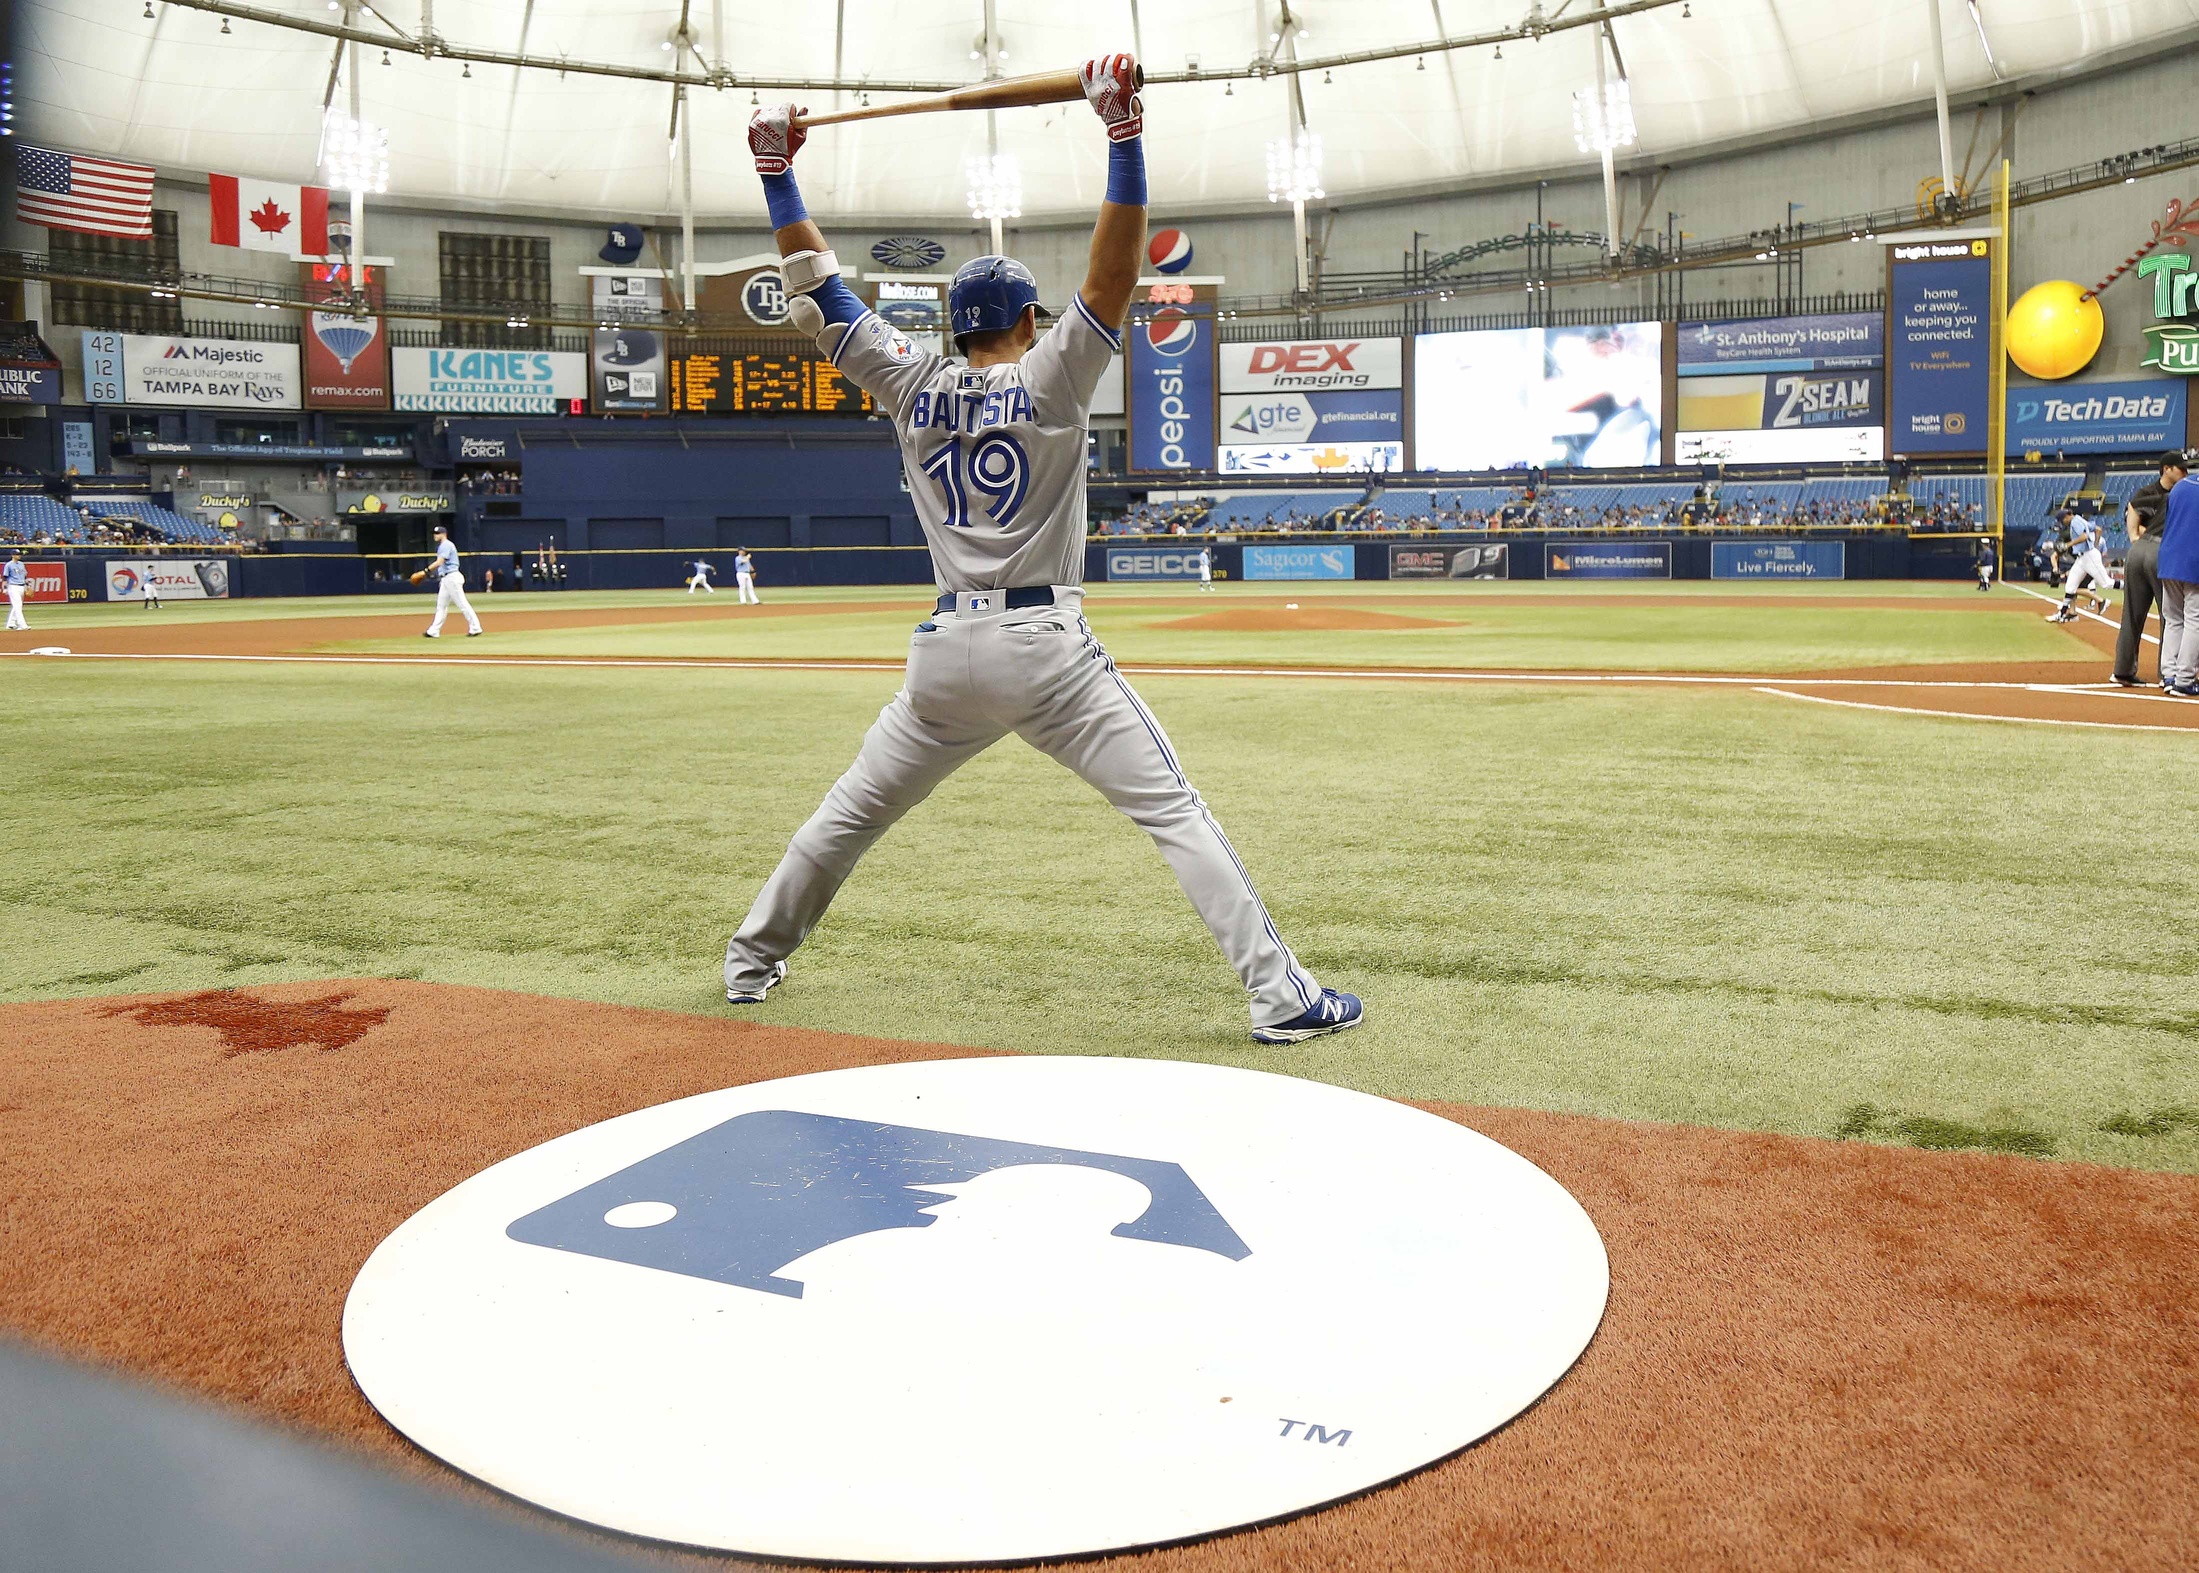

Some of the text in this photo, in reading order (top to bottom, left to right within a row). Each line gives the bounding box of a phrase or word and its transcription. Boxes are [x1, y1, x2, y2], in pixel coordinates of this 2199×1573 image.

[1895, 245, 1968, 260] bright house
[2137, 252, 2199, 319] Tr
[1924, 288, 1958, 300] home
[965, 306, 981, 319] 19
[1914, 303, 1927, 313] or
[1905, 315, 1977, 329] keeping you
[1717, 325, 1869, 346] St. Anthony's Hospital
[1908, 327, 1974, 342] connected.
[91, 336, 115, 353] 42
[193, 346, 264, 365] Majestic
[1248, 343, 1361, 374] DEX
[95, 360, 113, 376] 12
[429, 350, 553, 381] KANE'S
[143, 366, 283, 381] OFFICIAL UNIFORM OF THE
[1273, 372, 1370, 388] imaging
[93, 382, 117, 399] 66
[143, 380, 203, 395] TAMPA
[208, 383, 240, 396] BAY
[311, 386, 383, 397] remax.com
[434, 383, 547, 394] FURNITURE
[914, 386, 1032, 433] BAUTSTA
[1259, 402, 1301, 428] gte
[2044, 397, 2101, 422] Tech
[2103, 395, 2168, 419] Data
[1154, 368, 1192, 468] pepsi
[1322, 411, 1397, 424] gtefinancial.org
[1912, 415, 1940, 425] bright
[1912, 424, 1940, 432] house
[2021, 433, 2165, 447] PROUDLY SUPPORTING TAMPA BAY
[461, 446, 505, 457] PORCH
[919, 432, 1029, 527] 19
[201, 494, 250, 508] Ducky's
[400, 495, 448, 510] Ducky's
[1111, 555, 1200, 575] GEICO
[1253, 549, 1317, 570] Sagicor
[1397, 552, 1444, 566] GMC
[1737, 561, 1816, 576] Live Fiercely.
[25, 577, 62, 593] arm
[154, 575, 196, 585] OTAL
[69, 589, 88, 599] 370
[1279, 1418, 1353, 1447] TM
